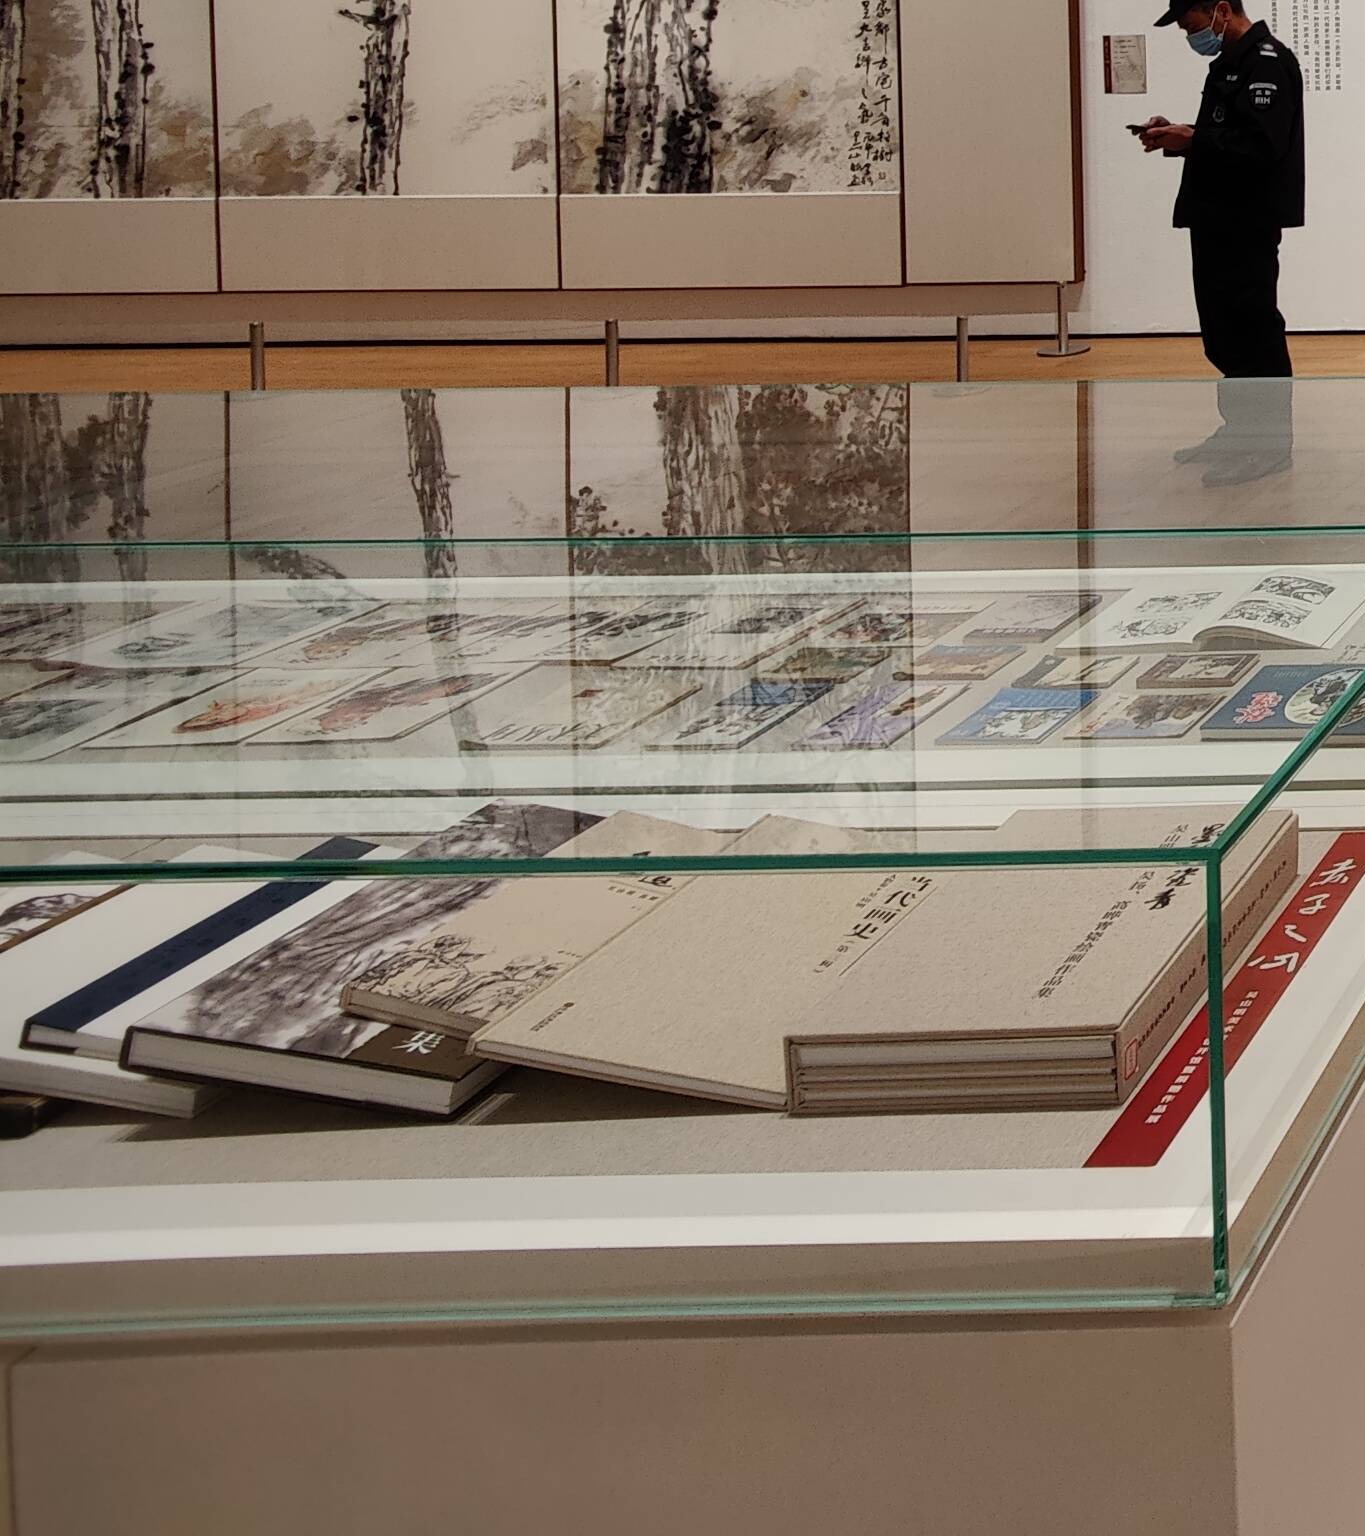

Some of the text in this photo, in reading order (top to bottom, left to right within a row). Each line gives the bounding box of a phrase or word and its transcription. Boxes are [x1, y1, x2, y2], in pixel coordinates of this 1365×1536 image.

[843, 876, 932, 940] 当代画史
[392, 1030, 445, 1055] 集
